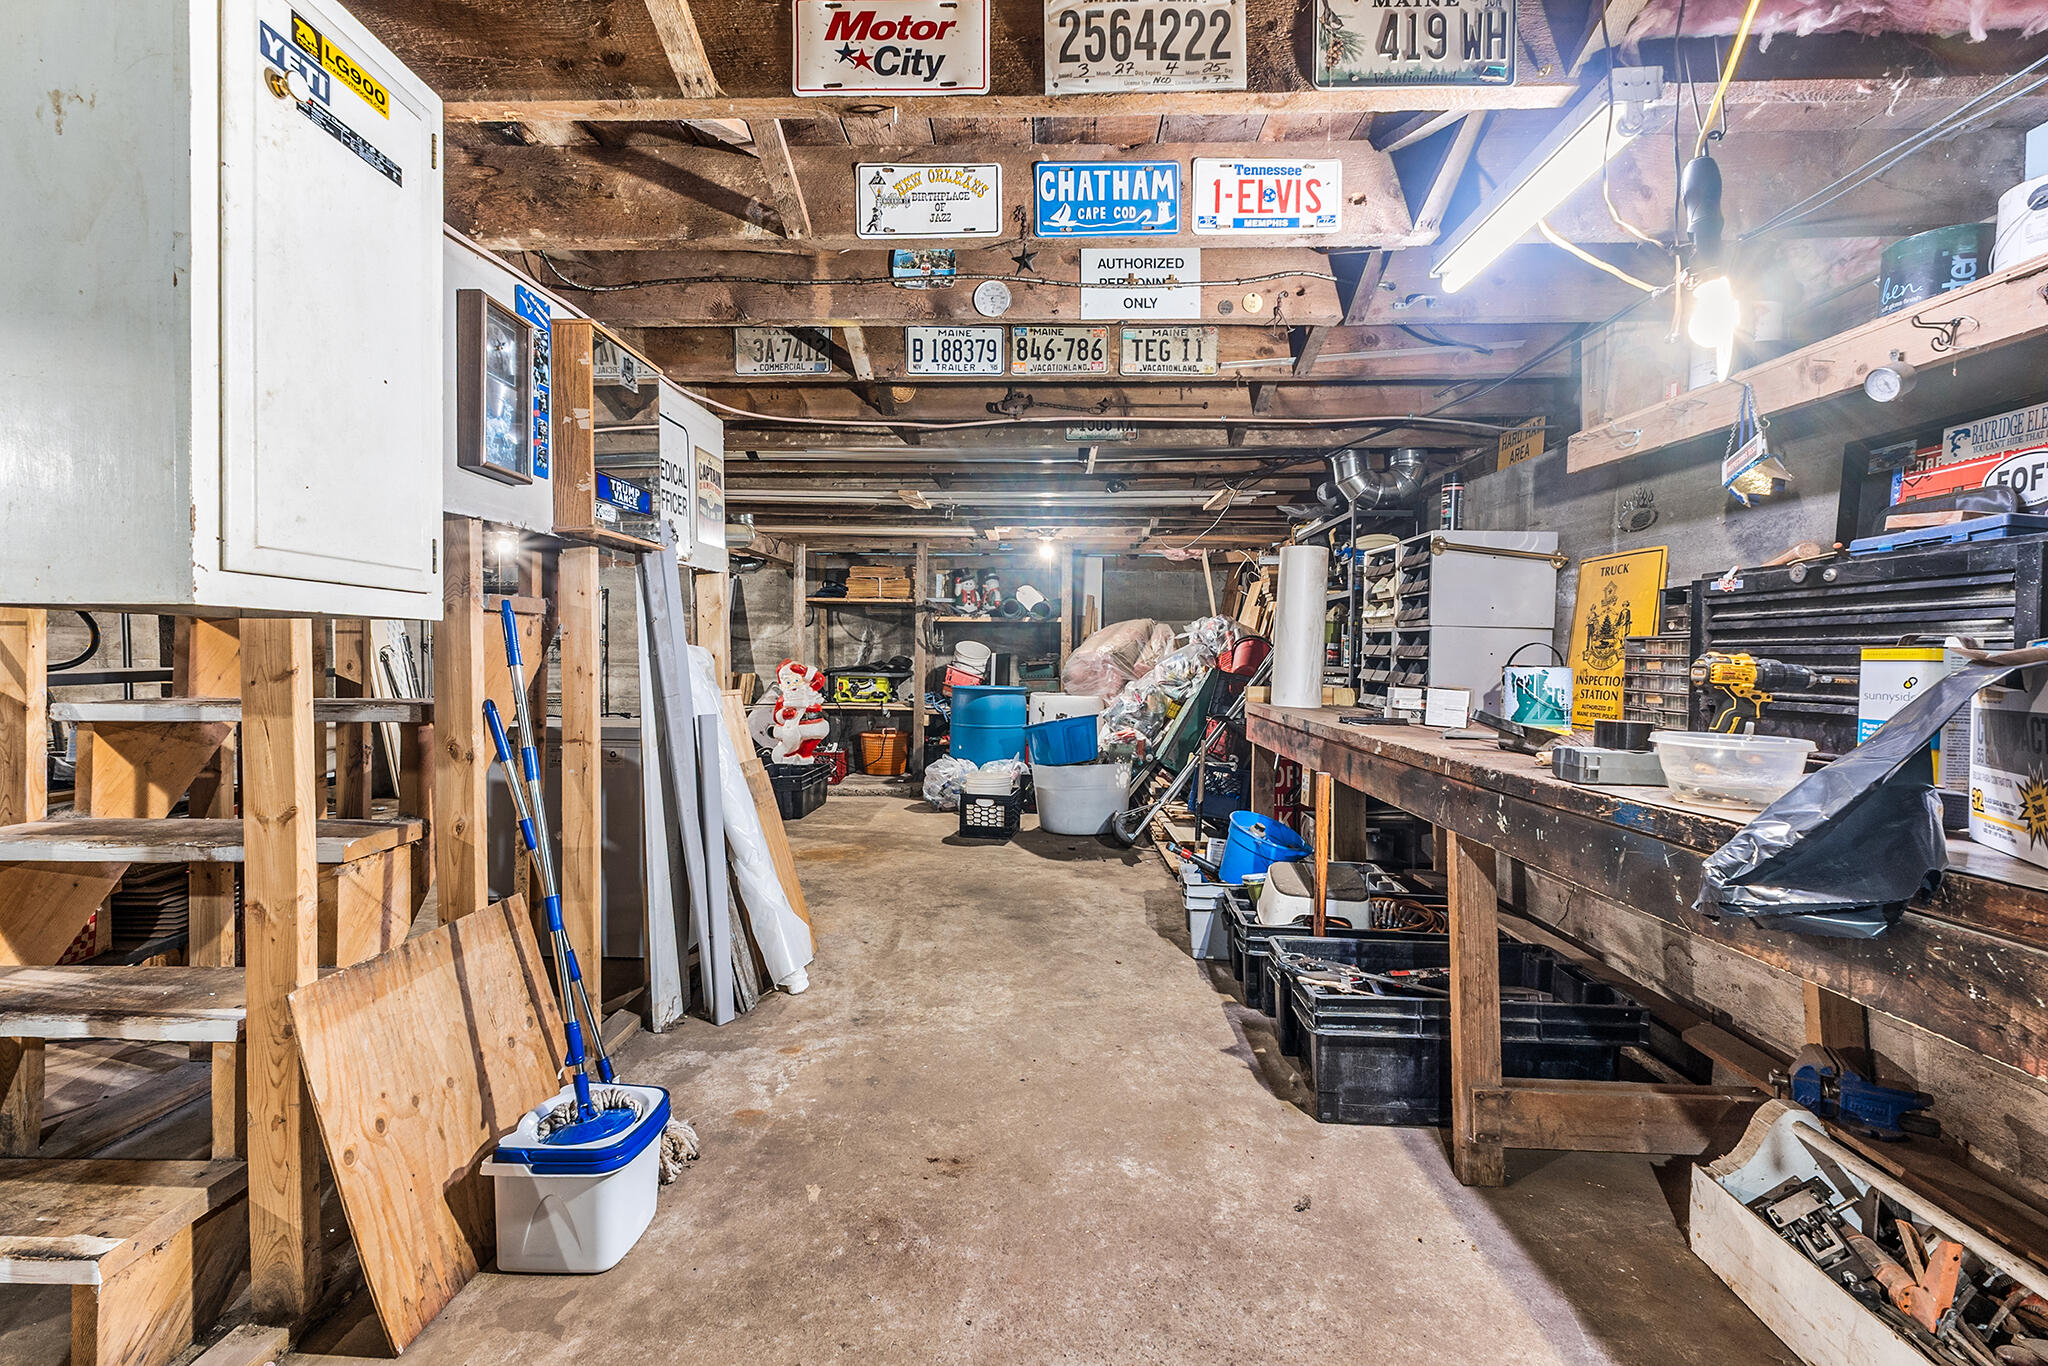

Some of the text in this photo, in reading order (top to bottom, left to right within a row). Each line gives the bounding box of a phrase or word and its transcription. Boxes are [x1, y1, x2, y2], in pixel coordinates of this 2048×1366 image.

[824, 11, 957, 41] Motor
[1059, 8, 1232, 63] 2564222
[1378, 13, 1507, 61] 419 WH
[262, 27, 330, 99] YETI
[873, 45, 946, 82] City
[1077, 63, 1090, 78] 3
[1114, 62, 1134, 75] 27
[1166, 61, 1179, 75] 4
[1202, 62, 1227, 74] 25
[325, 44, 385, 105] LG900
[1374, 71, 1457, 83] Vacationland
[1234, 164, 1302, 176] Tennessee
[893, 168, 989, 198] NEW ORLEANS
[1040, 170, 1175, 201] CHATHAM
[912, 192, 970, 202] BIRTHPLACE
[1213, 178, 1322, 213] 1-ELVIS
[935, 203, 946, 211] OF
[1078, 206, 1137, 219] CAPE COD
[930, 213, 952, 222] JAZZ
[1243, 218, 1289, 228] MEMPHIS
[1098, 257, 1184, 269] AUTHORIZED
[1100, 277, 1182, 289] PERONNL
[1124, 298, 1158, 309] ONLY
[938, 329, 972, 337] MAINE
[1033, 328, 1064, 336] MAINE
[1152, 329, 1188, 337] MAINE
[913, 338, 997, 363] B 188379
[1016, 338, 1103, 361] 846-786
[1131, 339, 1171, 362] TEG
[759, 362, 806, 372] COMMERCIAL
[936, 363, 976, 371] TRAILER
[1032, 363, 1088, 371] VACATIONLAND
[1142, 364, 1198, 372] VACATIONLAND
[1971, 412, 2025, 446] BAYRIDGE
[1501, 431, 1523, 451] HARD
[1972, 444, 1986, 454] YOU
[2006, 436, 2024, 447] HIDE
[2025, 431, 2045, 443] THAT
[1509, 443, 1529, 465] AREA
[660, 458, 688, 490] EDICAL
[610, 479, 641, 499] TRUMP
[613, 490, 638, 506] VANCE
[660, 488, 689, 518] FFICER
[1601, 563, 1630, 577] TRUCK
[1580, 689, 1619, 701] STATION
[1581, 703, 1606, 711] AUTHORIZED
[1972, 787, 1984, 812] 32
